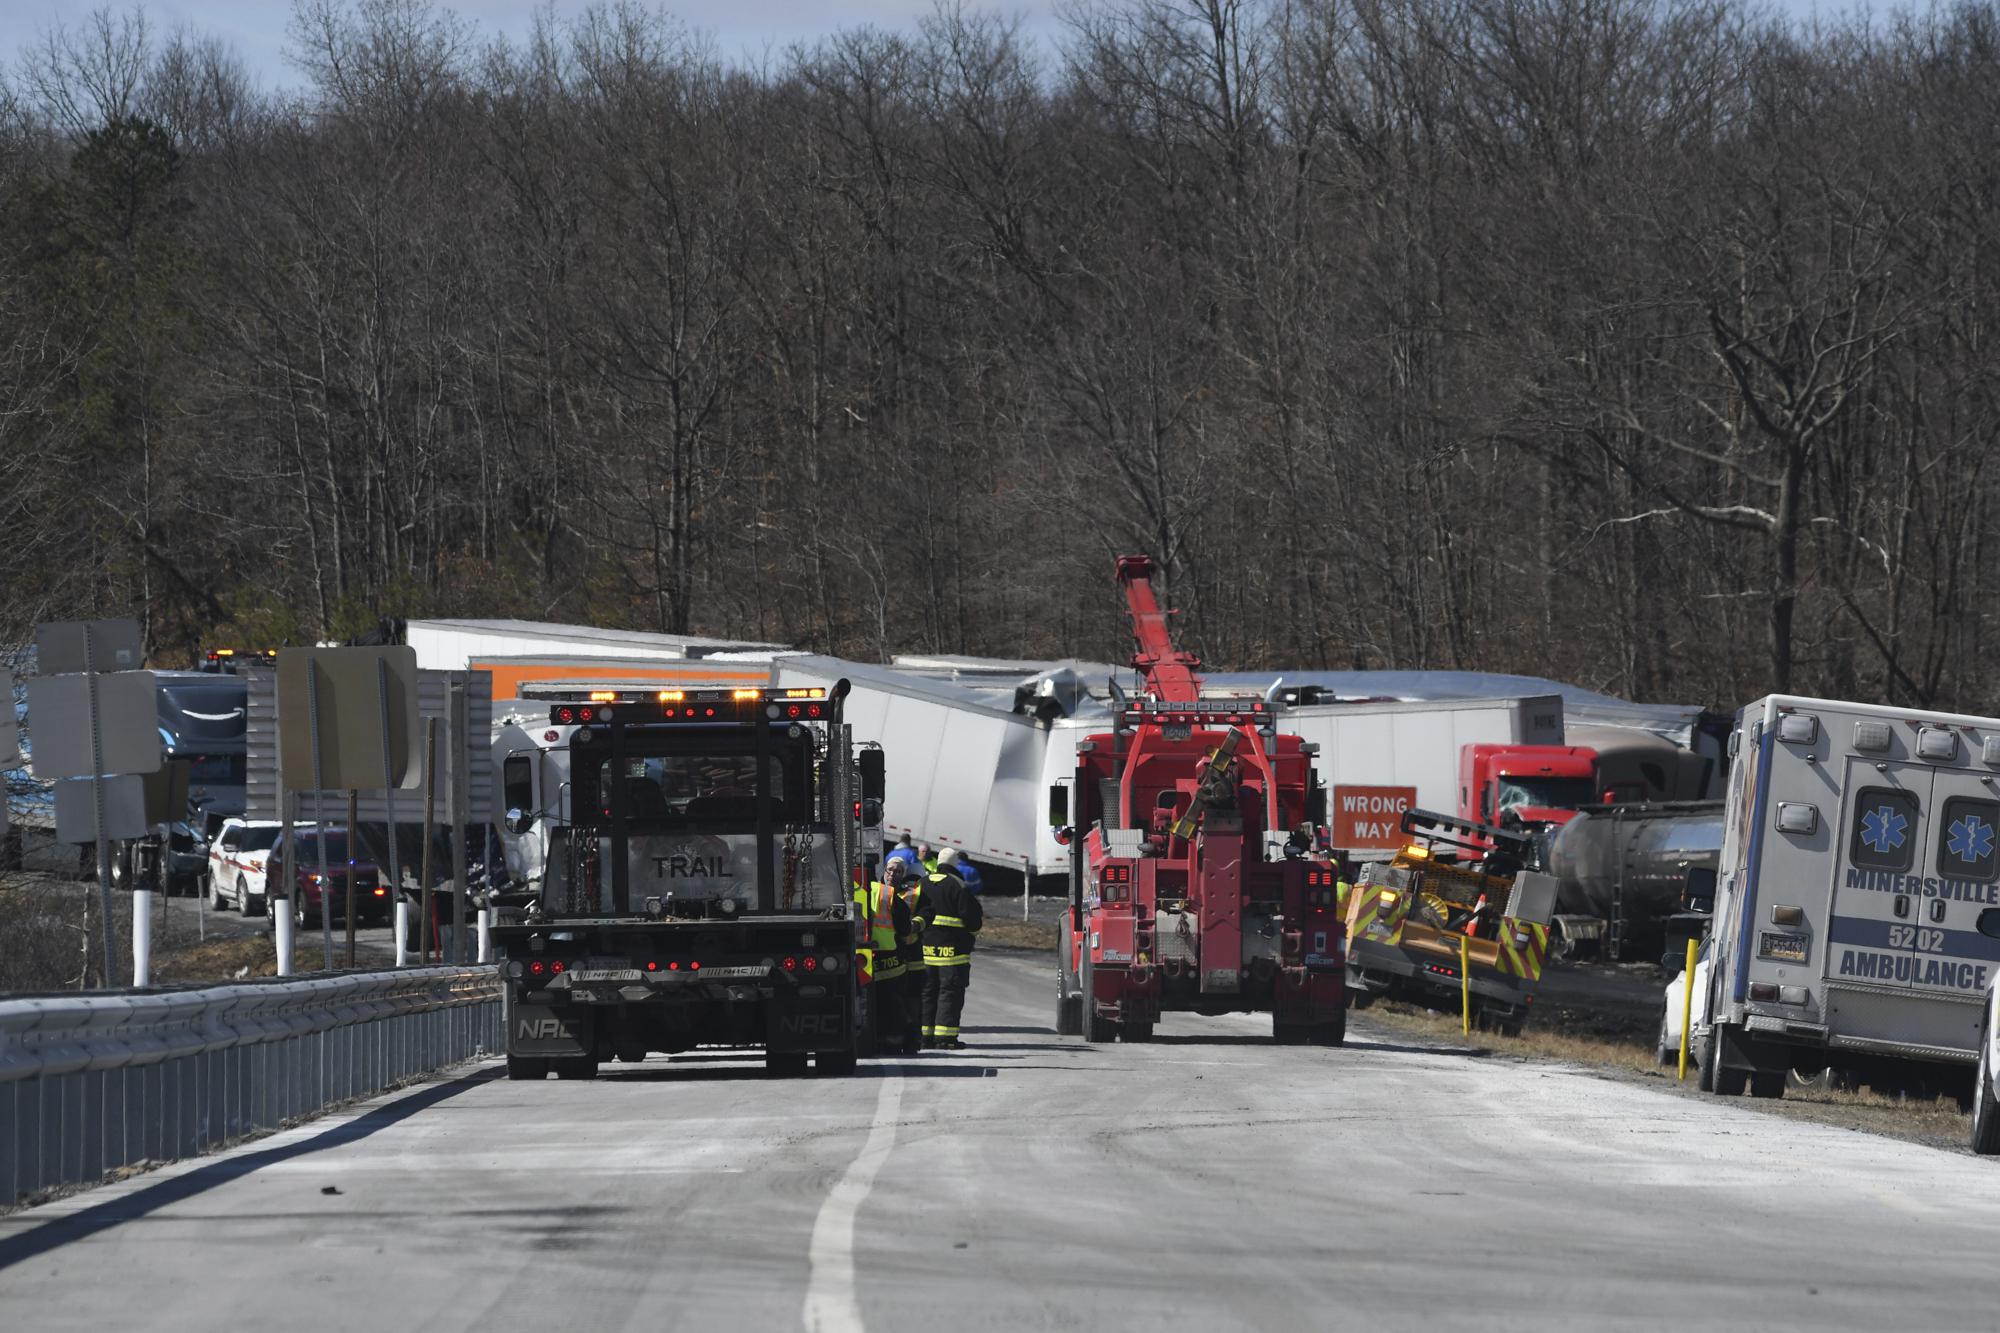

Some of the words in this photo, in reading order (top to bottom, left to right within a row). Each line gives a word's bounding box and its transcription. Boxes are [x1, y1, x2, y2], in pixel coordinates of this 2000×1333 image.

[1343, 796, 1408, 814] WRONG
[1355, 821, 1393, 839] WAY
[652, 856, 733, 878] TRAIL
[1846, 869, 1999, 904] MINERSVILLE
[1888, 925, 1944, 952] 5202
[938, 947, 954, 957] 705
[883, 956, 899, 969] 705
[1840, 950, 1987, 991] AMBULANCE
[519, 1019, 579, 1039] NRC
